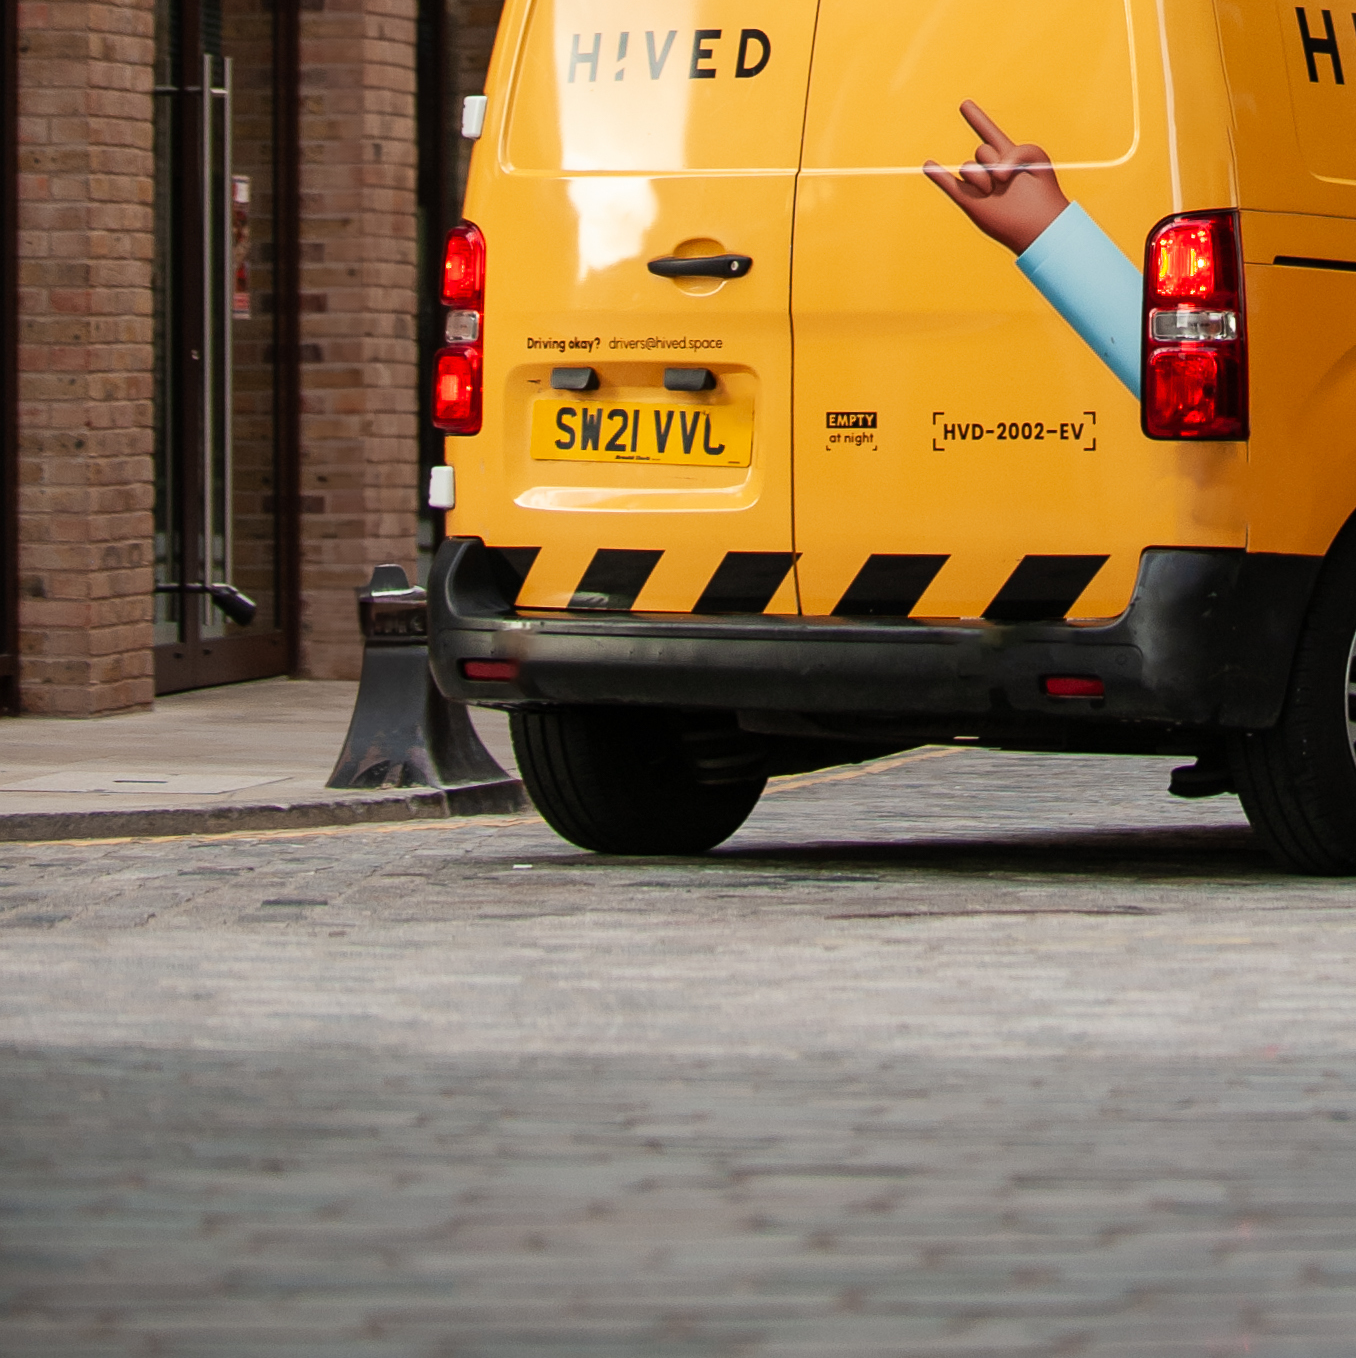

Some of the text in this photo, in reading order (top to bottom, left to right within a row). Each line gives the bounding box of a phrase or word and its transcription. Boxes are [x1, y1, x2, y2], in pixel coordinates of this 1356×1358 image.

[527, 337, 723, 353] Driving okay? drivers@hived.space
[828, 413, 875, 427] EMPTY
[554, 406, 640, 453] SW21
[829, 432, 874, 446] at night
